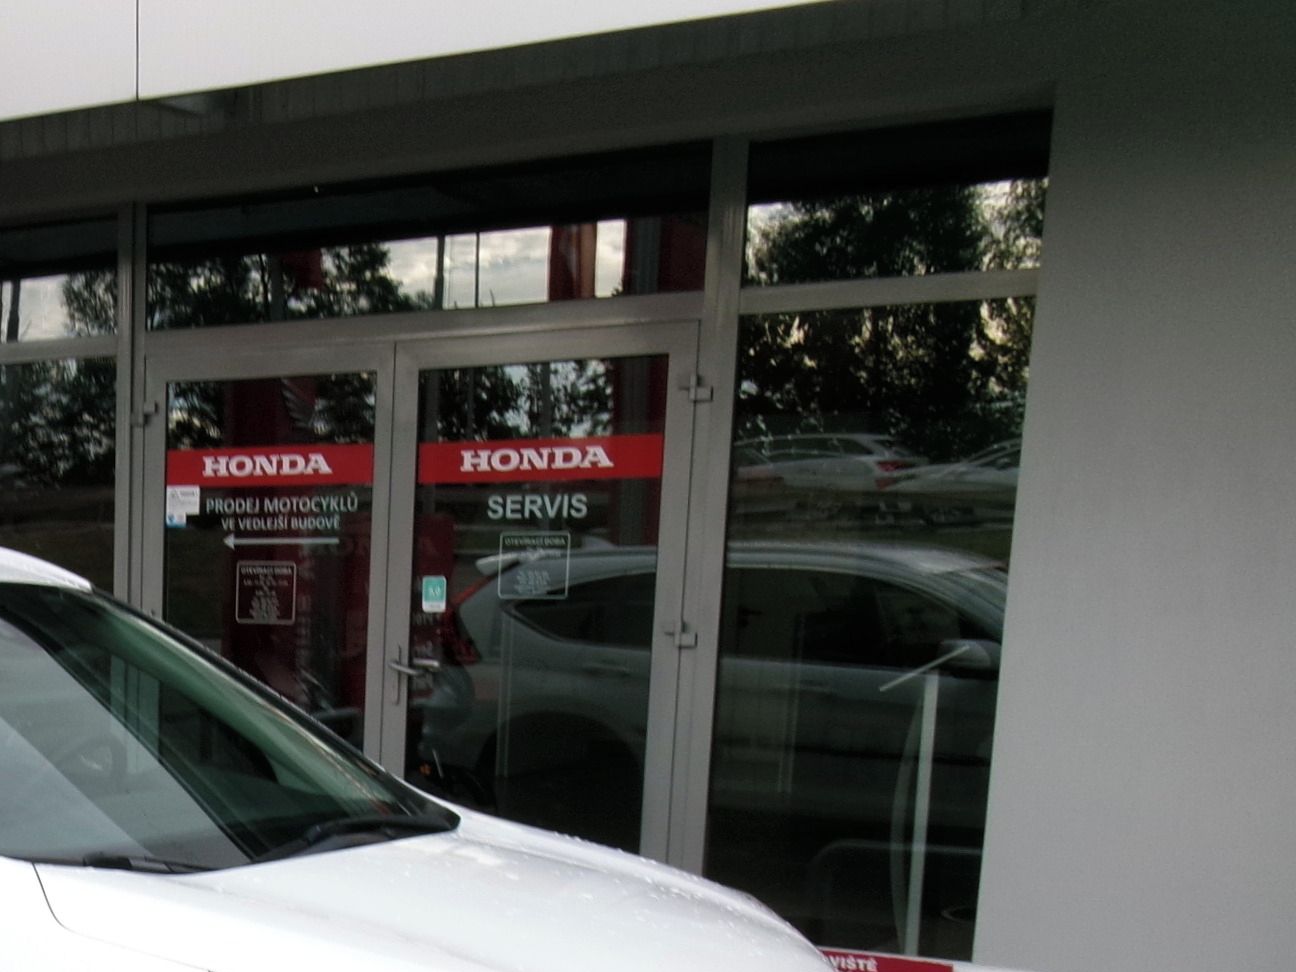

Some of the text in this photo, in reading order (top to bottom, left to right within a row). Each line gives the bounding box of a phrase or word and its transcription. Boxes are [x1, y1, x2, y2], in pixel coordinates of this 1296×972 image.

[202, 453, 333, 478] HONDA
[459, 445, 615, 472] HONDA
[206, 498, 260, 514] PRODEJ
[487, 493, 589, 519] SERVIS
